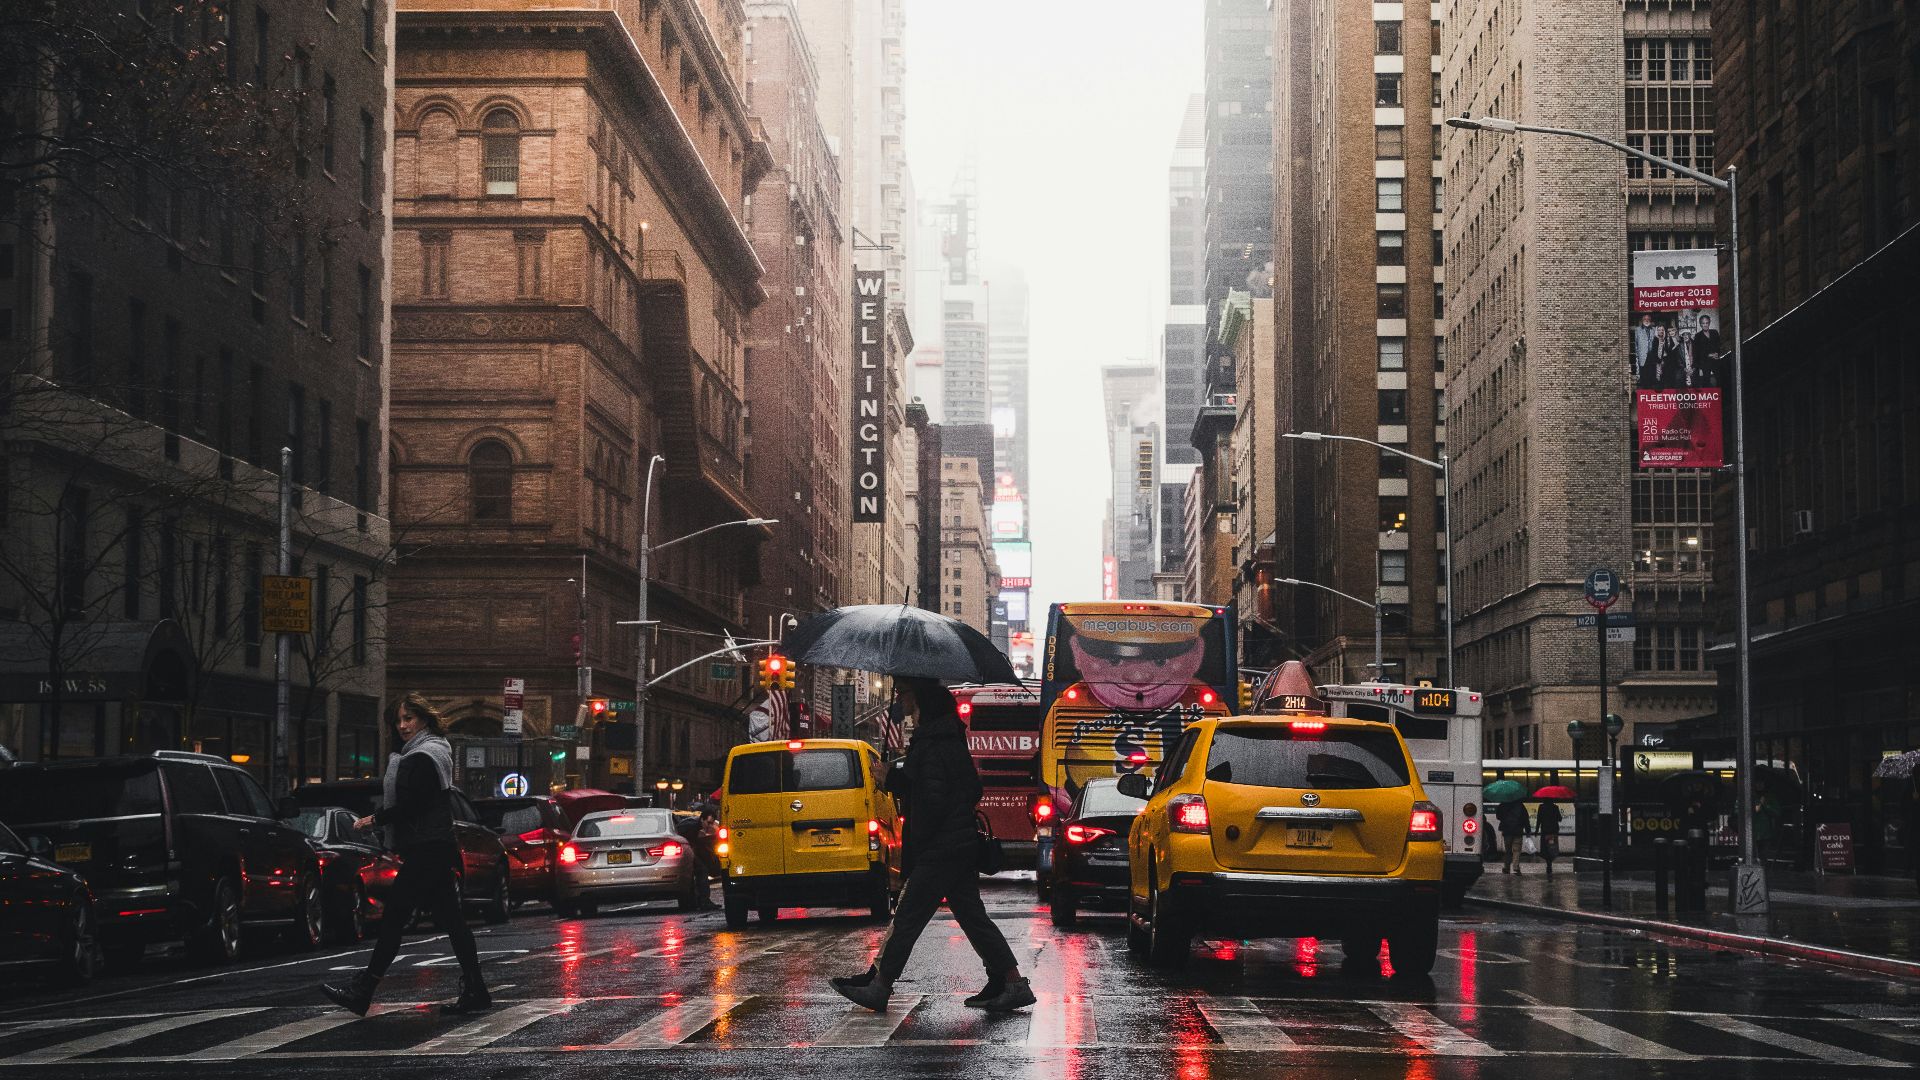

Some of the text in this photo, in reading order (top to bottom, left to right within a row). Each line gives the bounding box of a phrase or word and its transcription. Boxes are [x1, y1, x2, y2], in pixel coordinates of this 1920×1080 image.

[1655, 265, 1696, 280] NYC
[1687, 288, 1712, 297] 2018
[1639, 300, 1669, 308] Person
[1669, 298, 1679, 306] of
[1695, 297, 1715, 306] Year
[857, 278, 882, 515] WELLINGTON
[1639, 393, 1719, 402] FLEETWOOD MAC
[1678, 402, 1711, 410] CONCERT
[1642, 418, 1658, 426] JAN
[1642, 426, 1658, 435] 26
[1578, 615, 1596, 626] M20
[1083, 619, 1194, 634] megabus.com
[1046, 636, 1057, 681] DD769
[88, 680, 106, 694] 58
[993, 692, 1031, 700] TOPVIEW
[1379, 692, 1405, 704] 6700
[1421, 691, 1450, 707] M104
[1285, 696, 1306, 709] 2H14
[1819, 834, 1851, 843] europa
